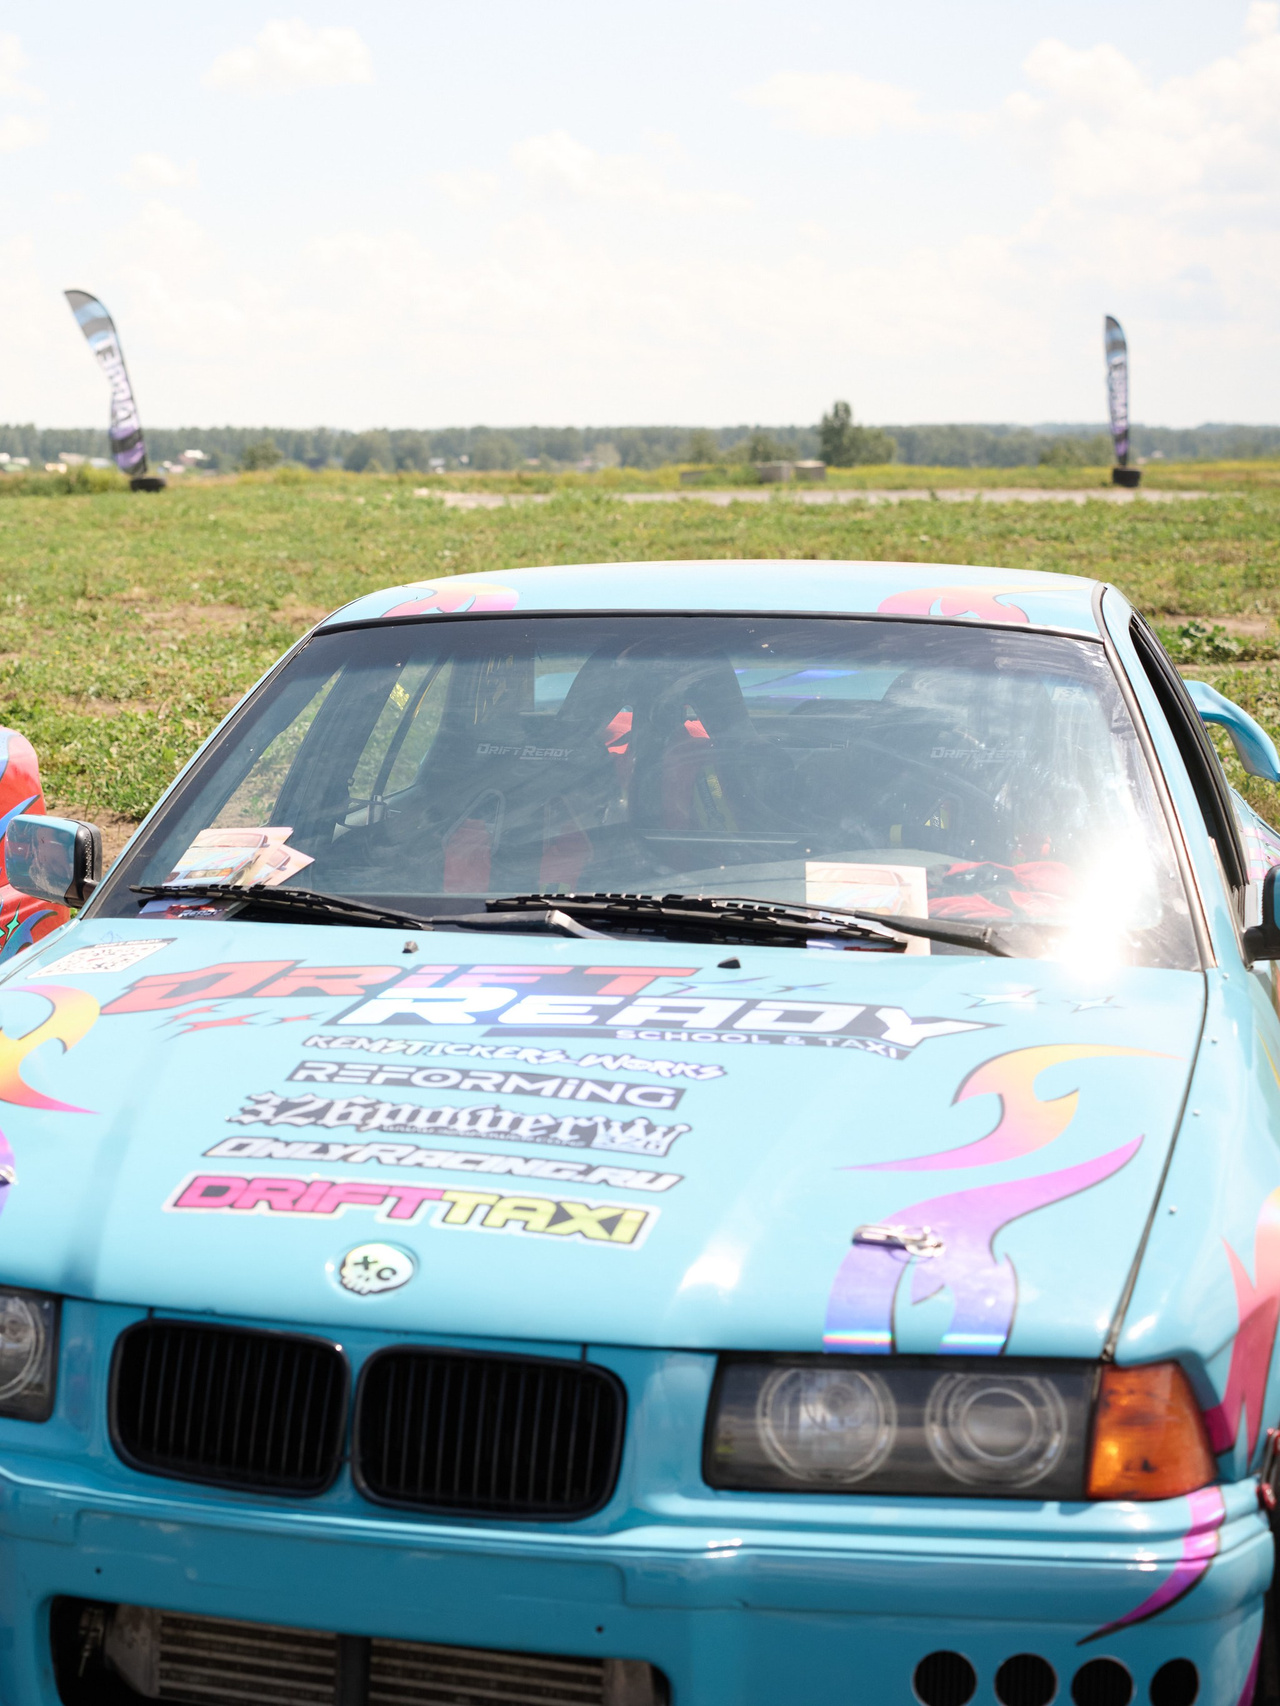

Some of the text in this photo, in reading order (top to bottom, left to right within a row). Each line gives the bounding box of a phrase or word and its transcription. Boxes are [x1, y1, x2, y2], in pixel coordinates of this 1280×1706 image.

[476, 743, 574, 758] DRIFT READY
[99, 960, 700, 1015] DRIFT
[336, 986, 988, 1048] READY
[616, 1029, 899, 1059] SCHOOL & TAXI
